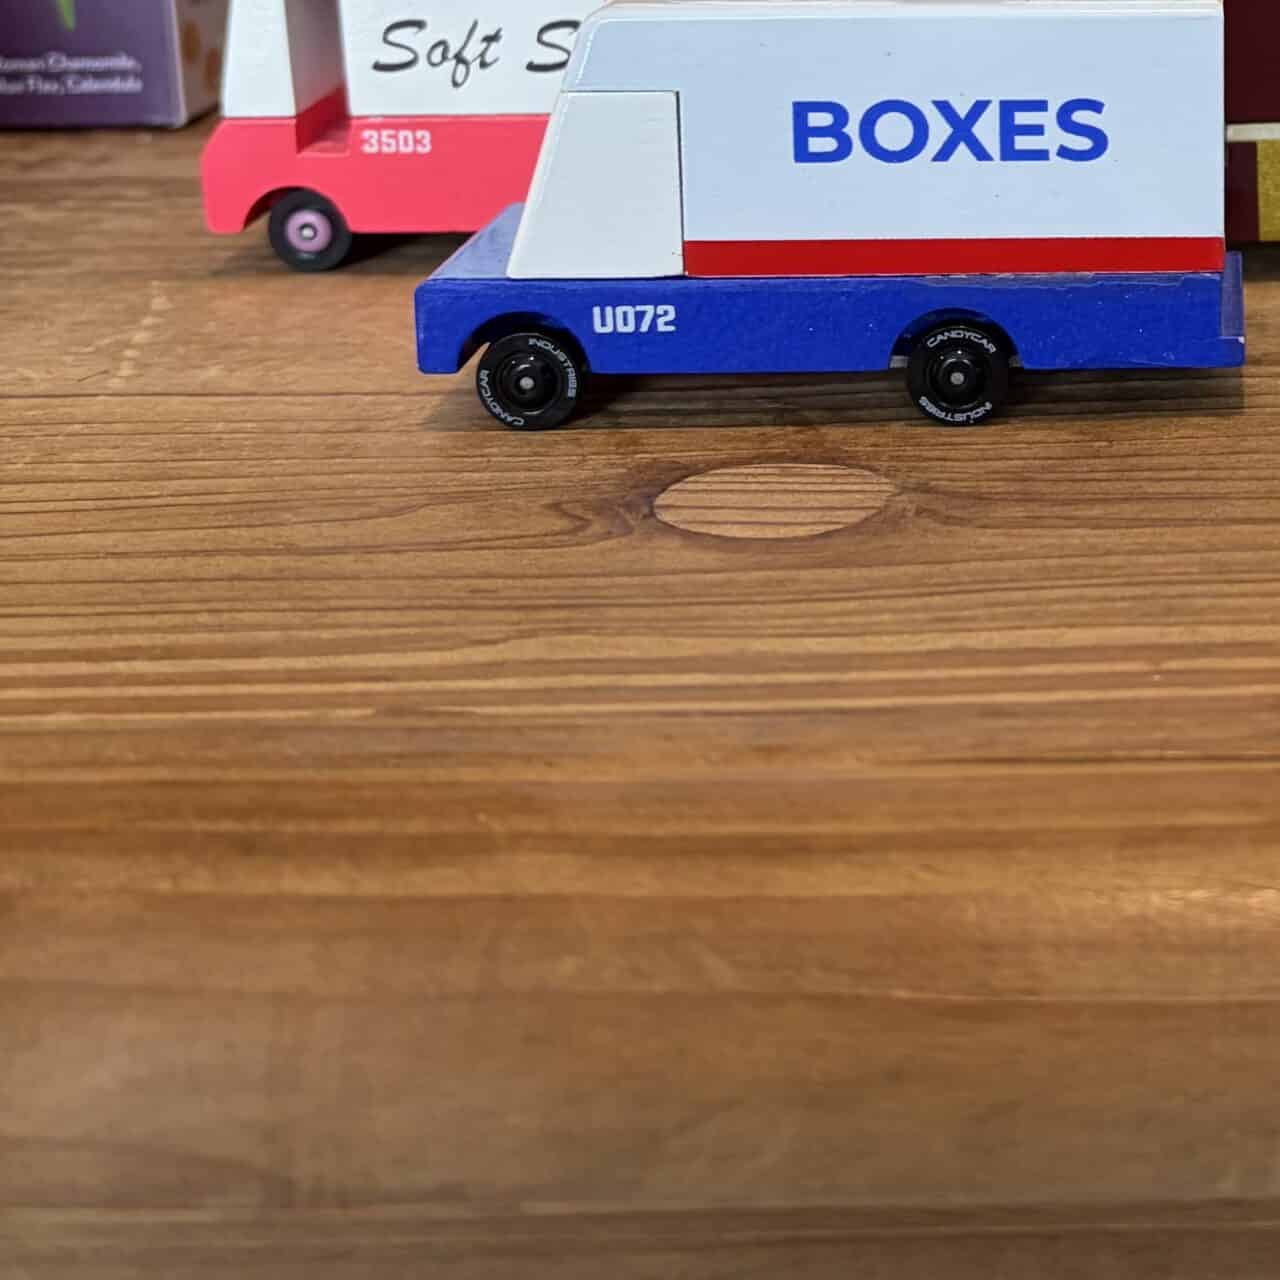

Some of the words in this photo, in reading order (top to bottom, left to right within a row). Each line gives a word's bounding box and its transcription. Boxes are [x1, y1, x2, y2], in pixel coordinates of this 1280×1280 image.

[371, 19, 503, 89] Soft
[361, 129, 432, 155] 3503
[792, 98, 1109, 164] BOXES
